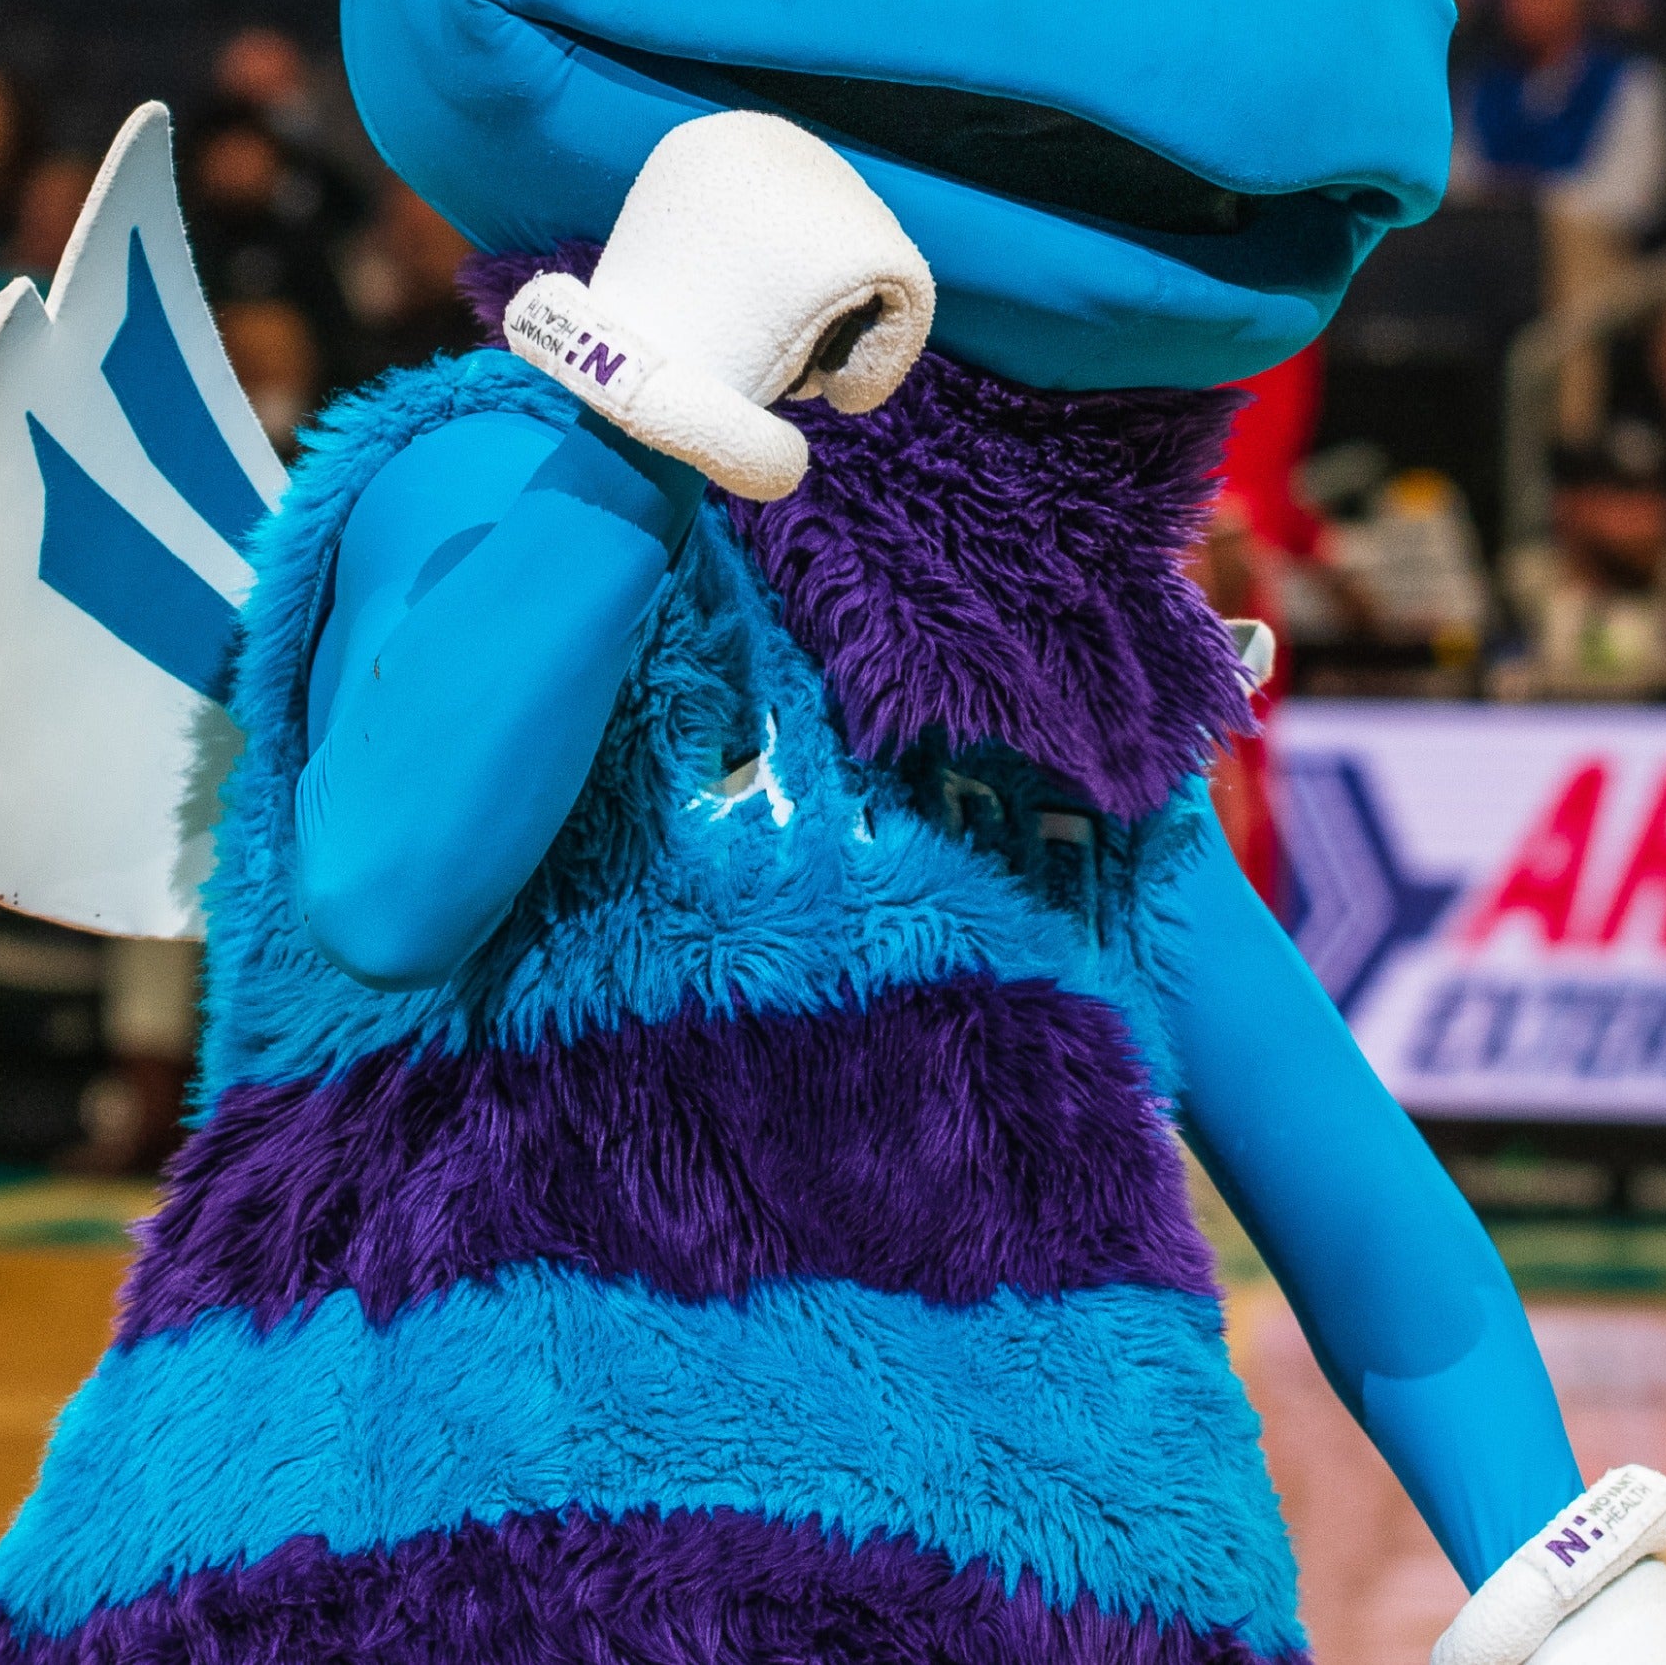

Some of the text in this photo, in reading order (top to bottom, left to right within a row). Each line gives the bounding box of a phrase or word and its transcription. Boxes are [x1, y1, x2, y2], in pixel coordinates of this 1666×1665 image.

[510, 315, 564, 355] NOVANT
[524, 299, 579, 338] HEALTH
[1585, 1472, 1635, 1516] NOVANT
[1601, 1481, 1652, 1531] HEALTH
